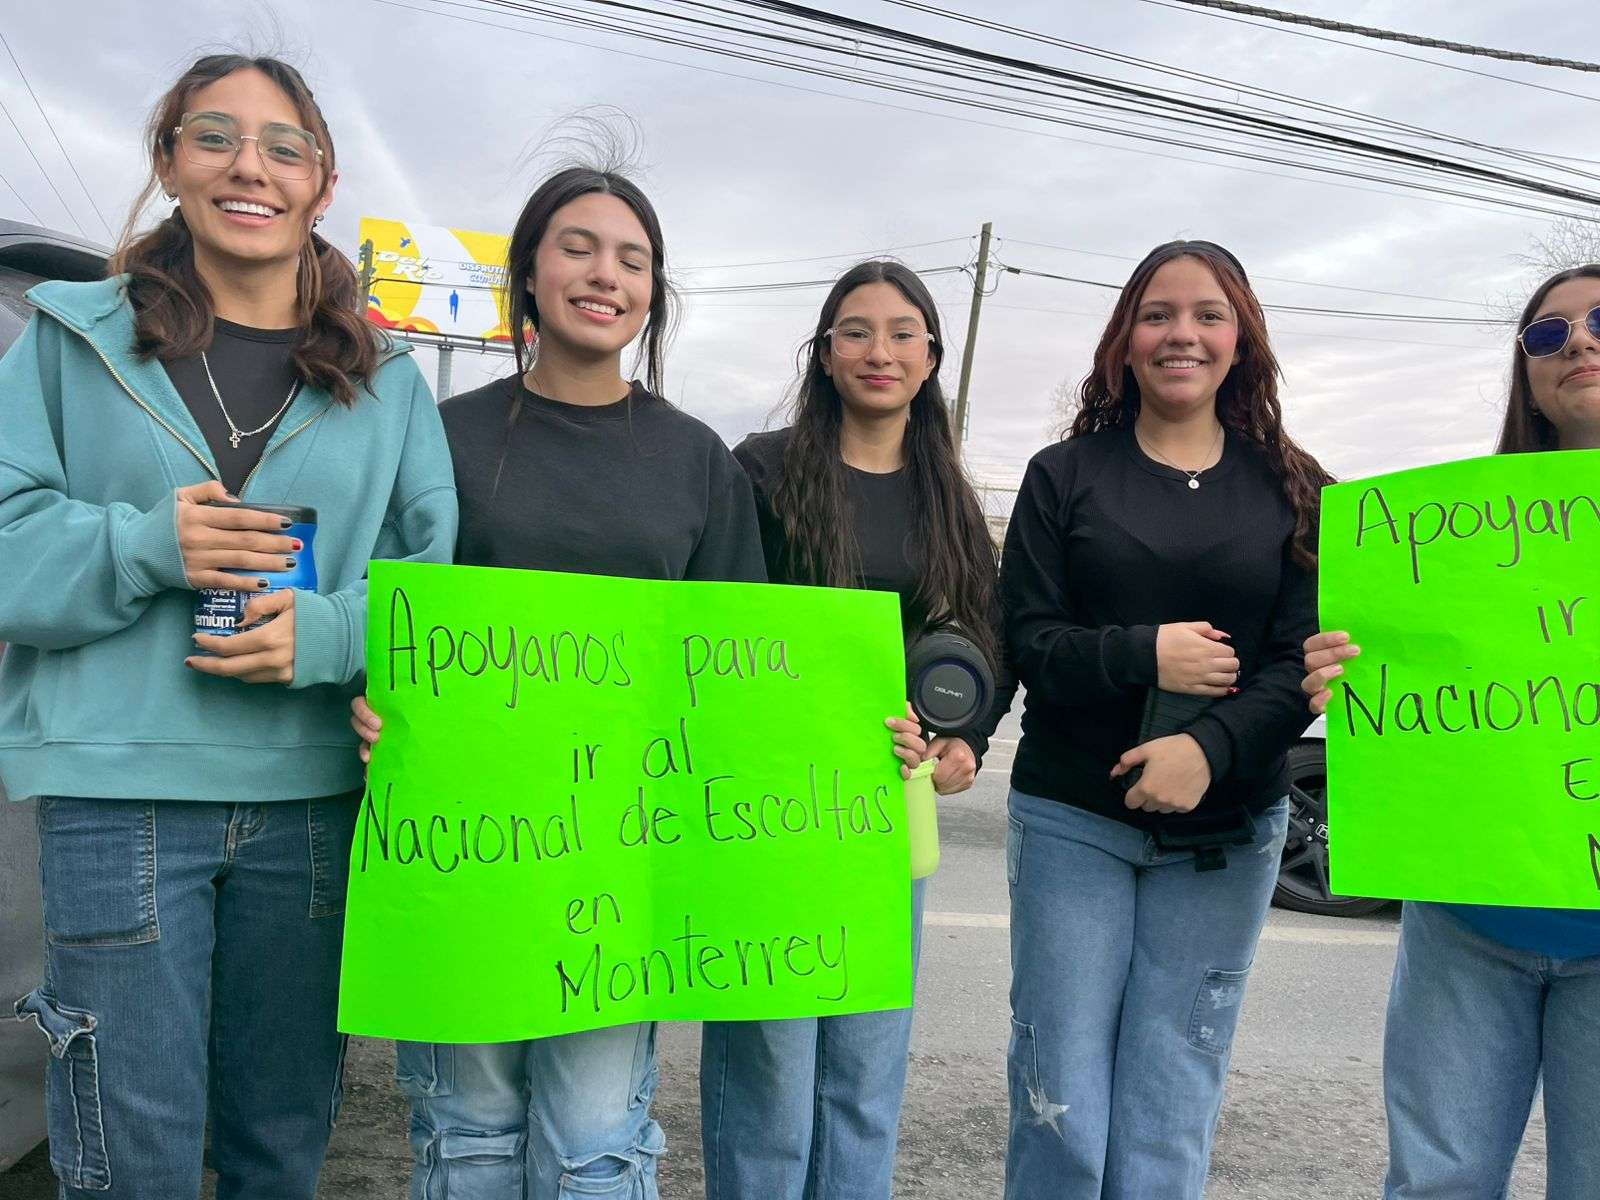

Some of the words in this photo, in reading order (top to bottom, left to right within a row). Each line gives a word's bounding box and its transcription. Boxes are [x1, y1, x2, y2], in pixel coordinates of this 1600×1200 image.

[388, 587, 631, 710] Apoyanos
[682, 634, 801, 707] para
[1532, 587, 1590, 644] ir
[1341, 663, 1600, 737] Naciona
[573, 732, 602, 783] ir
[642, 717, 694, 776] al
[361, 783, 582, 873] Nacional
[619, 786, 682, 847] de
[704, 763, 895, 841] Escoltas
[566, 892, 622, 934] en
[555, 915, 848, 1013] Monterrey
